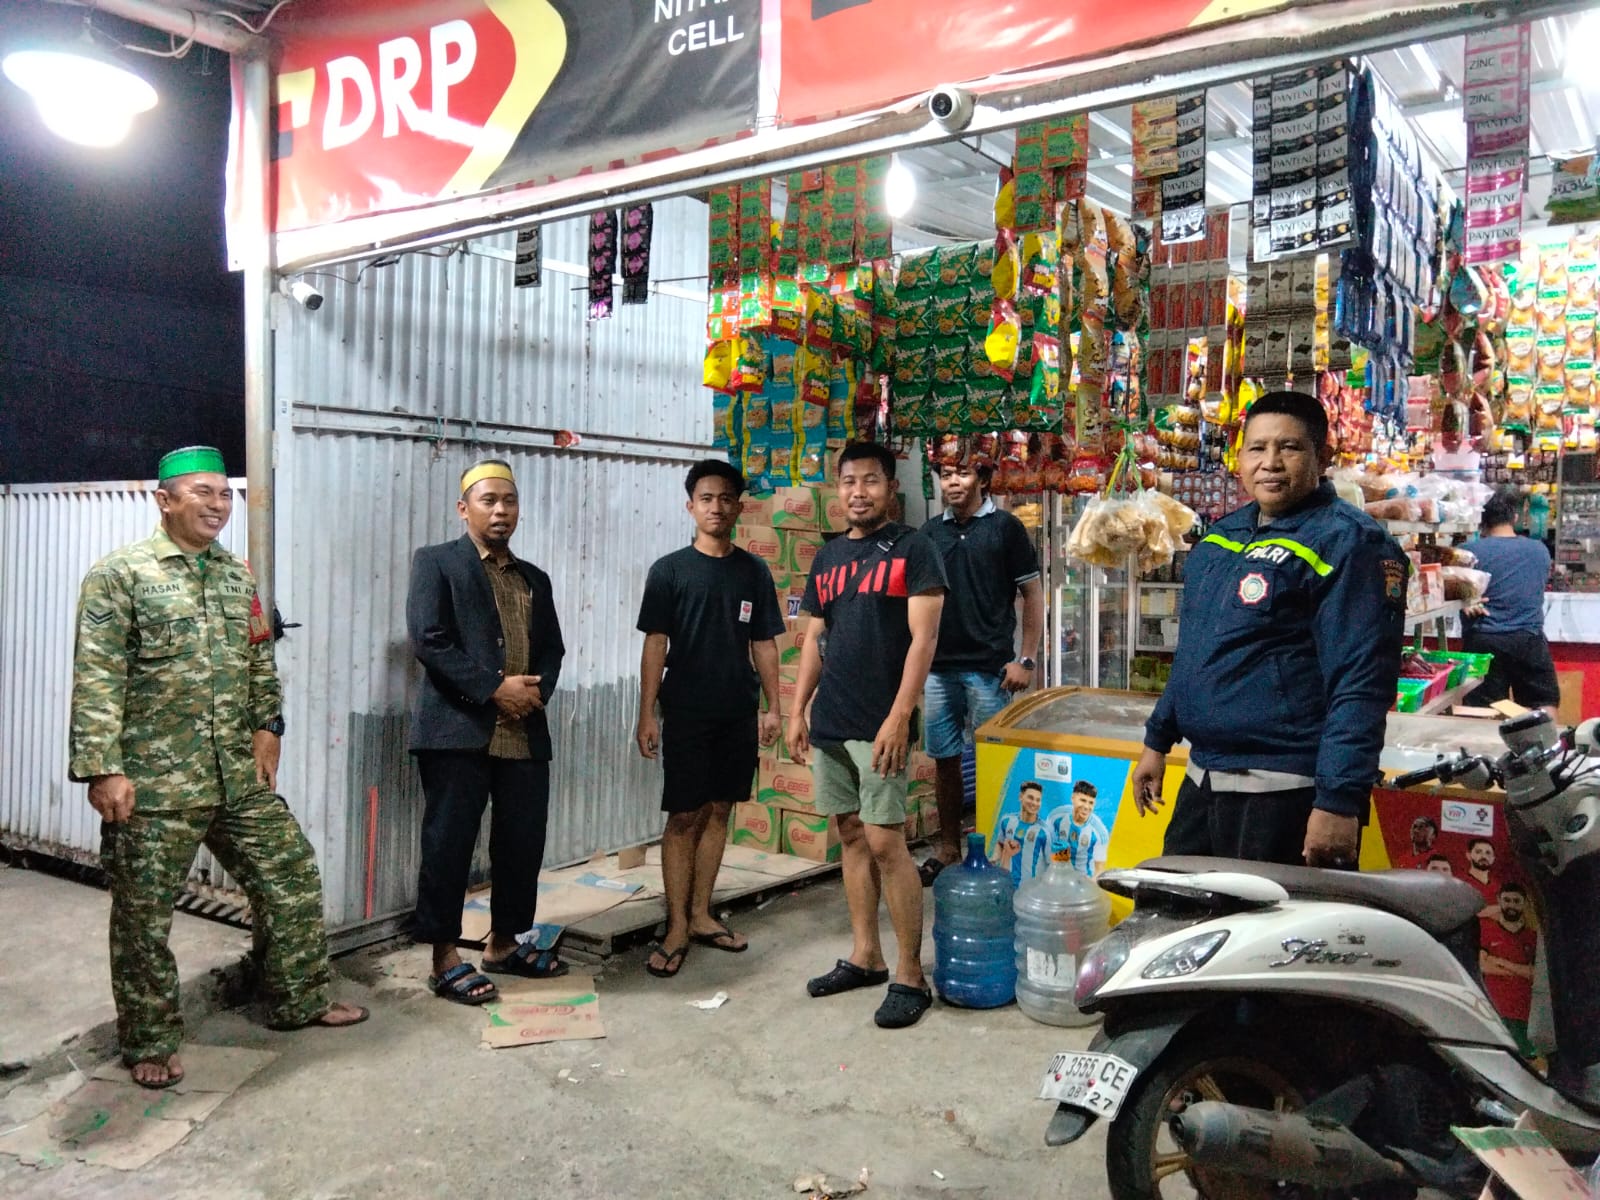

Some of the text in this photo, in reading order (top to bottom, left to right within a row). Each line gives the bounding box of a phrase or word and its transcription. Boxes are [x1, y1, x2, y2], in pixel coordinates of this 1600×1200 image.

[668, 15, 744, 56] CELL
[1469, 57, 1496, 70] ZINC
[322, 19, 478, 151] DRP
[1274, 89, 1313, 103] PANTENE
[1468, 93, 1496, 105] ZINC
[1476, 114, 1523, 129] PANTENE
[1273, 122, 1313, 136] PANTENE
[1273, 155, 1313, 168] PANTENE
[1471, 158, 1517, 171] PANTENE
[1164, 178, 1202, 192] PANTENE
[1470, 192, 1517, 206] PANTENE
[1468, 228, 1518, 242] PANTENE
[142, 583, 181, 596] HASAN
[224, 585, 242, 595] TNI
[1047, 1055, 1129, 1091] DD 3555 CE
[1067, 1085, 1114, 1111] 08 27
